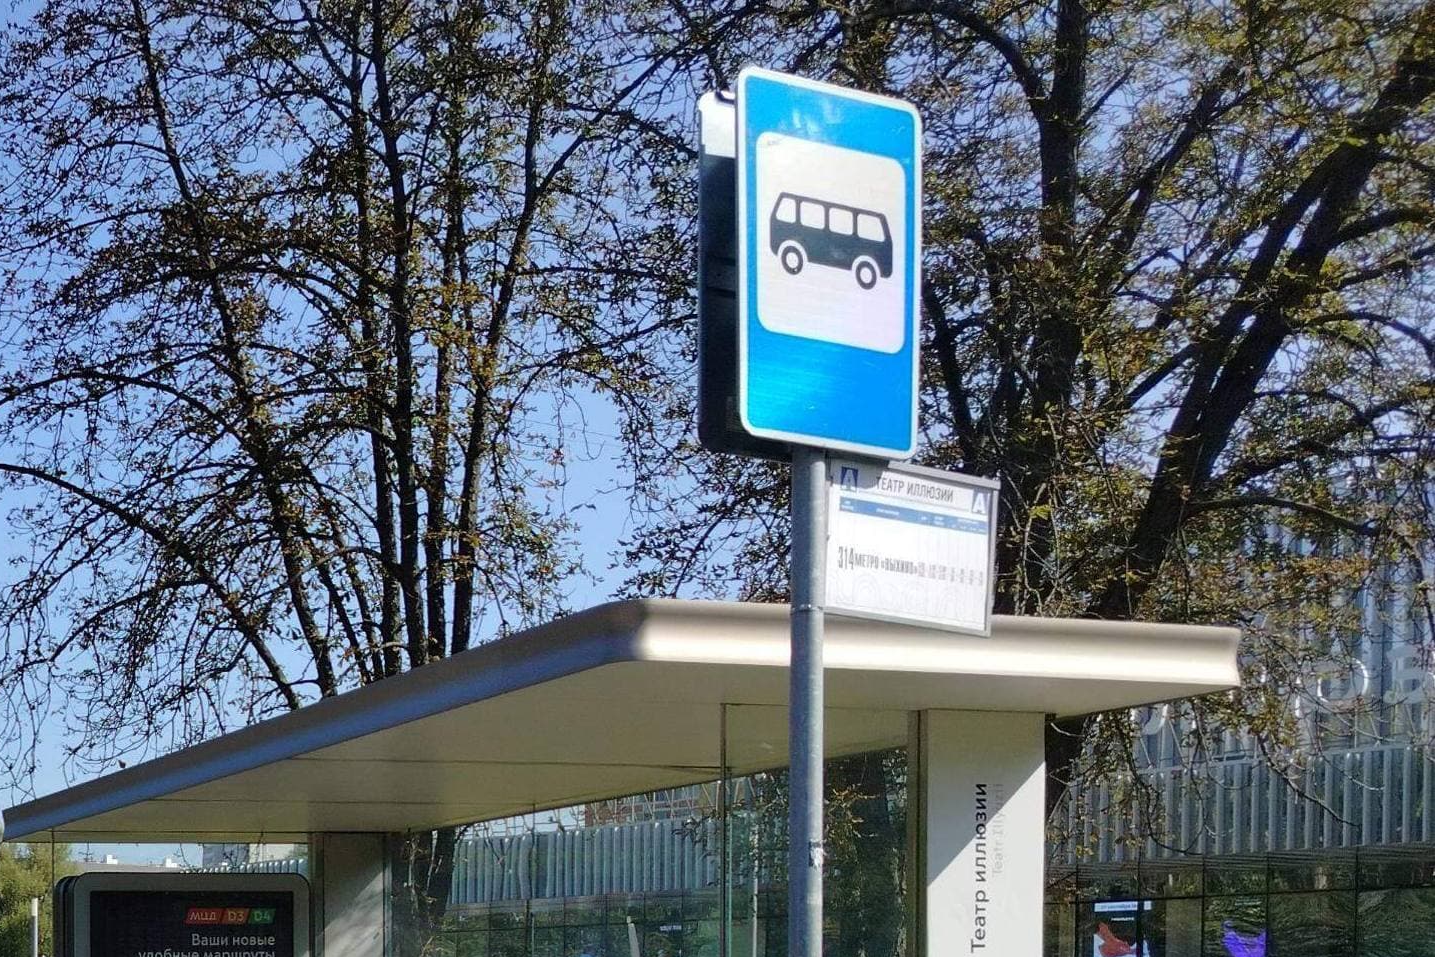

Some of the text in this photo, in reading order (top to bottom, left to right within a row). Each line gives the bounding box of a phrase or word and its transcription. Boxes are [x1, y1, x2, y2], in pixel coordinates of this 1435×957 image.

[876, 476, 905, 493] ТЕАТР
[837, 546, 854, 570] 314
[971, 783, 989, 953] Театр иллюзии
[191, 933, 276, 946] Ваши новые
